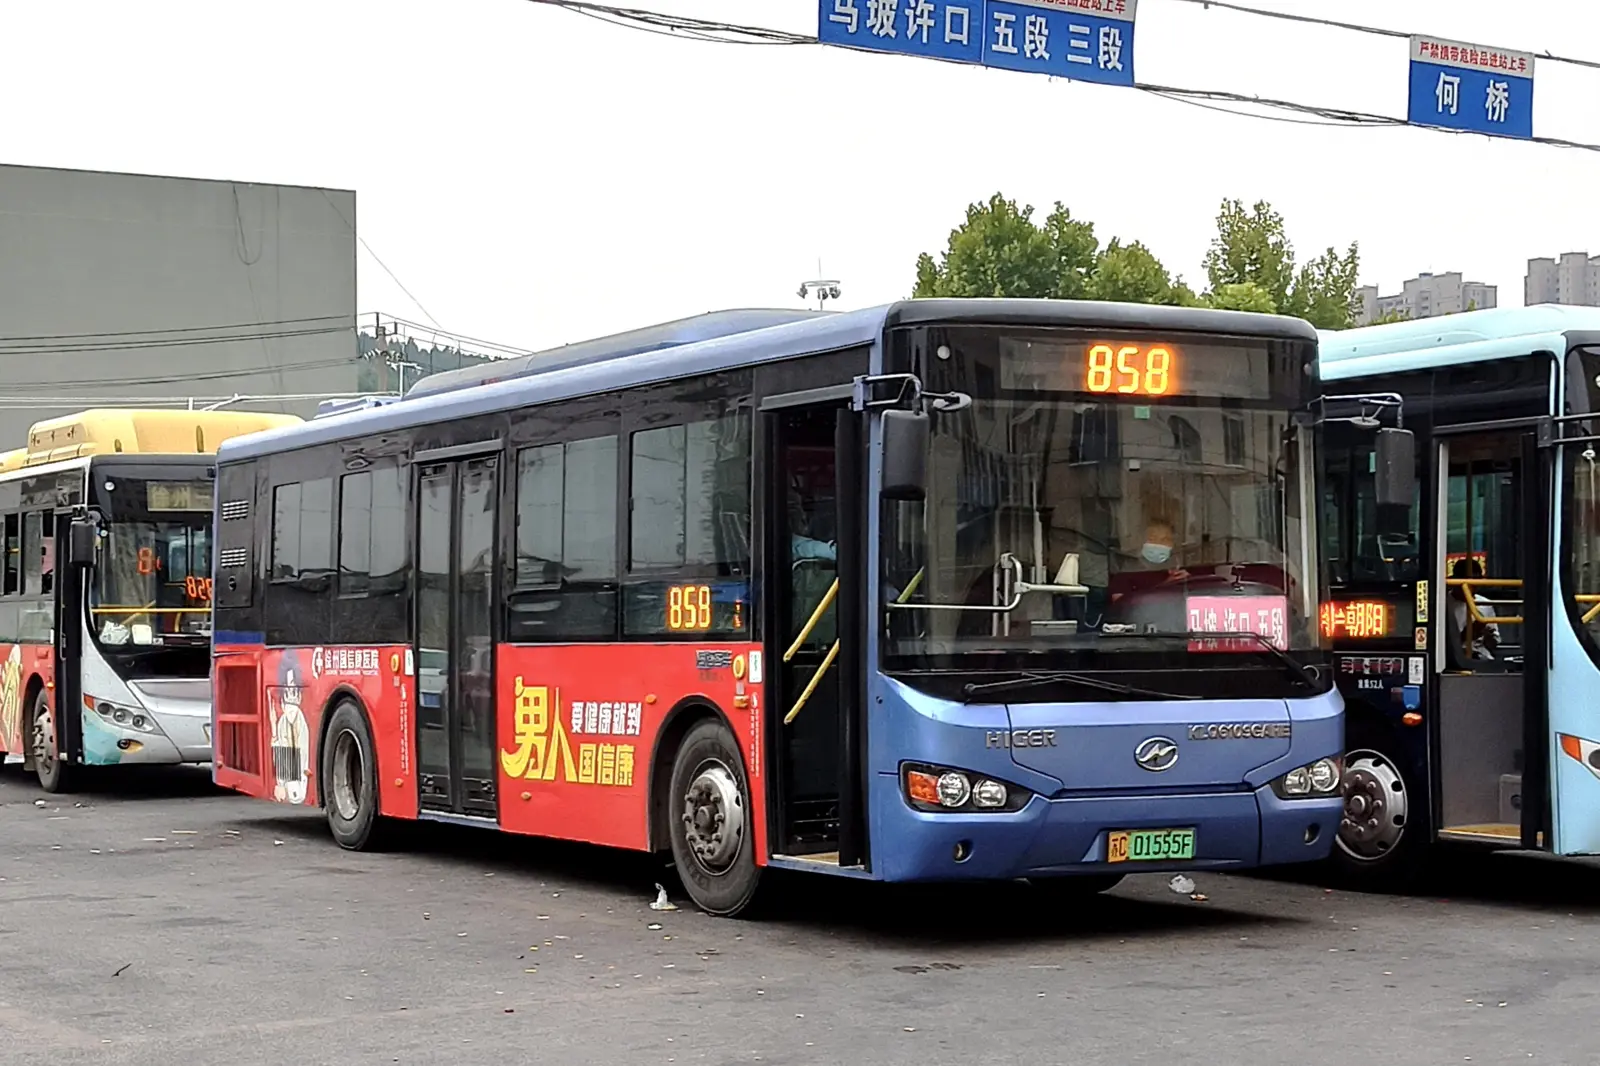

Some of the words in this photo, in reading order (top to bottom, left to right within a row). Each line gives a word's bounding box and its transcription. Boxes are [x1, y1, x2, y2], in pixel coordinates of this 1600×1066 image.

[829, 0, 970, 45] 马坡许口
[991, 11, 1050, 60] 五段
[1067, 24, 1123, 71] 三段
[1086, 344, 1170, 395] 858
[668, 585, 712, 629] 858
[500, 675, 579, 783] 男人
[571, 701, 642, 736] 要健康就到
[986, 729, 1058, 749] HIGER
[578, 743, 635, 787] 国信康
